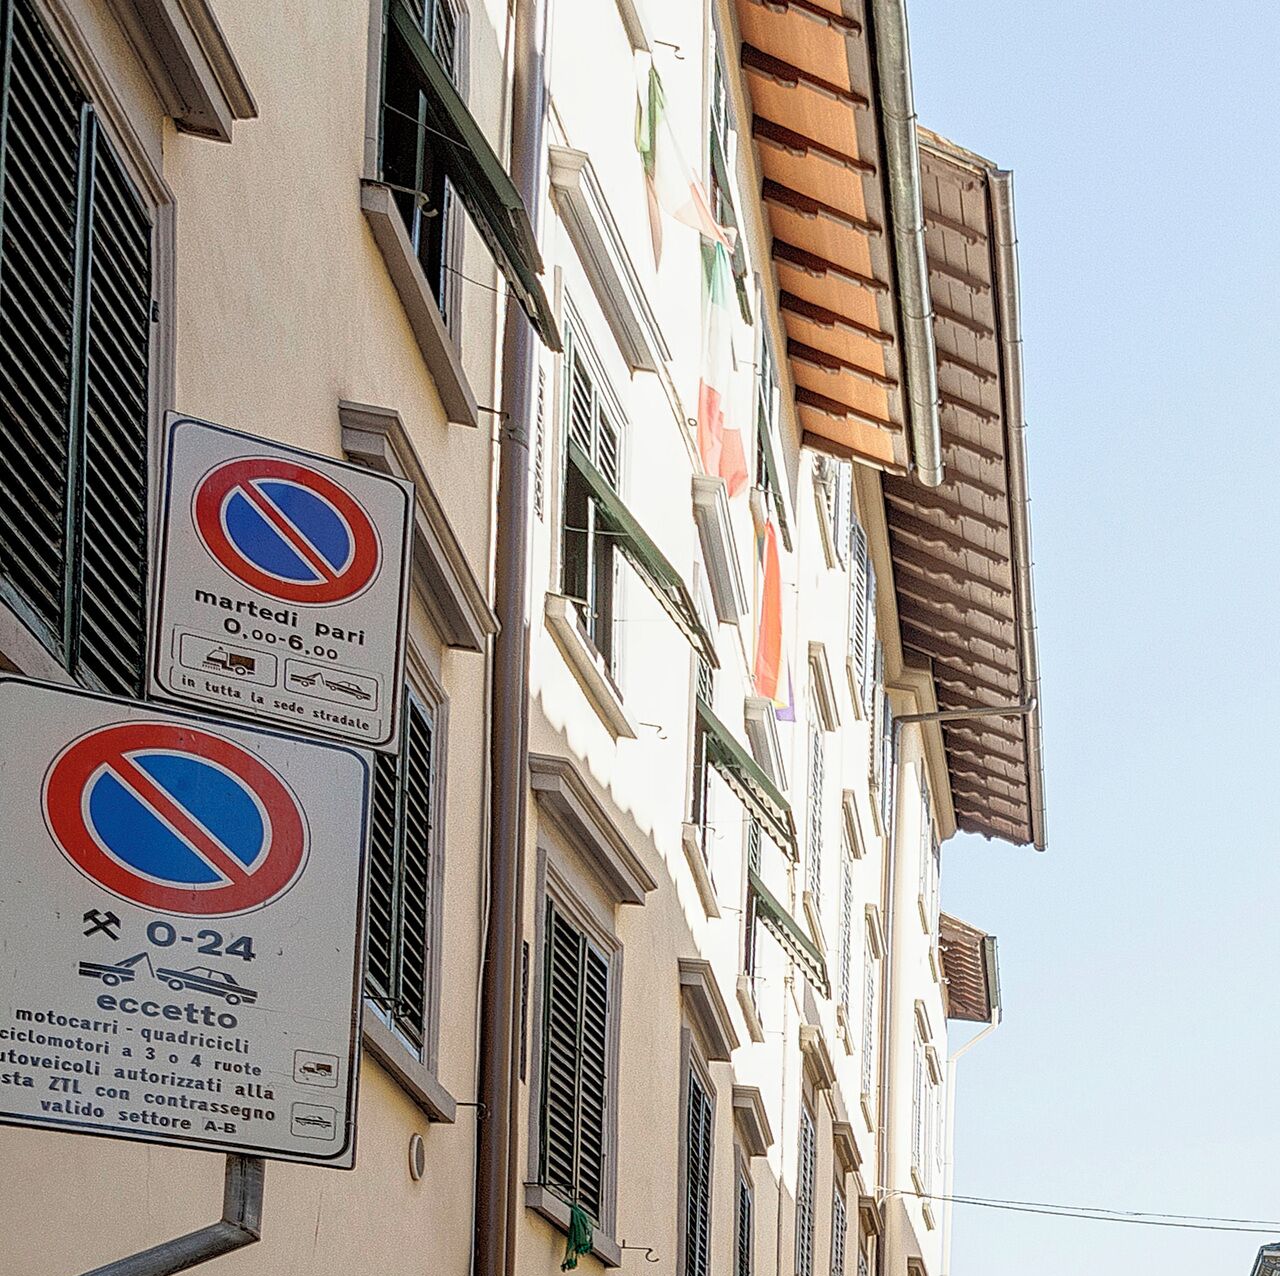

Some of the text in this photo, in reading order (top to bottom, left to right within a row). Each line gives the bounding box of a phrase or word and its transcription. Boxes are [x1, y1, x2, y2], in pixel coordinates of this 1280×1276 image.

[315, 621, 365, 646] pari
[182, 674, 370, 732] in tutta la sede stradale
[146, 920, 256, 961] 0-24
[97, 994, 238, 1029] eccetto
[16, 1008, 118, 1035] motocarri
[141, 1027, 249, 1054] quadricicli
[122, 1046, 132, 1058] a
[145, 1046, 156, 1060] 3
[168, 1053, 179, 1064] o
[190, 1054, 202, 1067] 4
[214, 1060, 262, 1077] ruote
[48, 1075, 82, 1095] ZTL
[95, 1085, 130, 1101] con
[143, 1093, 275, 1121] contrassegno
[114, 1067, 222, 1093] autorizzati
[235, 1083, 275, 1100] alla
[40, 1099, 237, 1134] valido settore A-B
